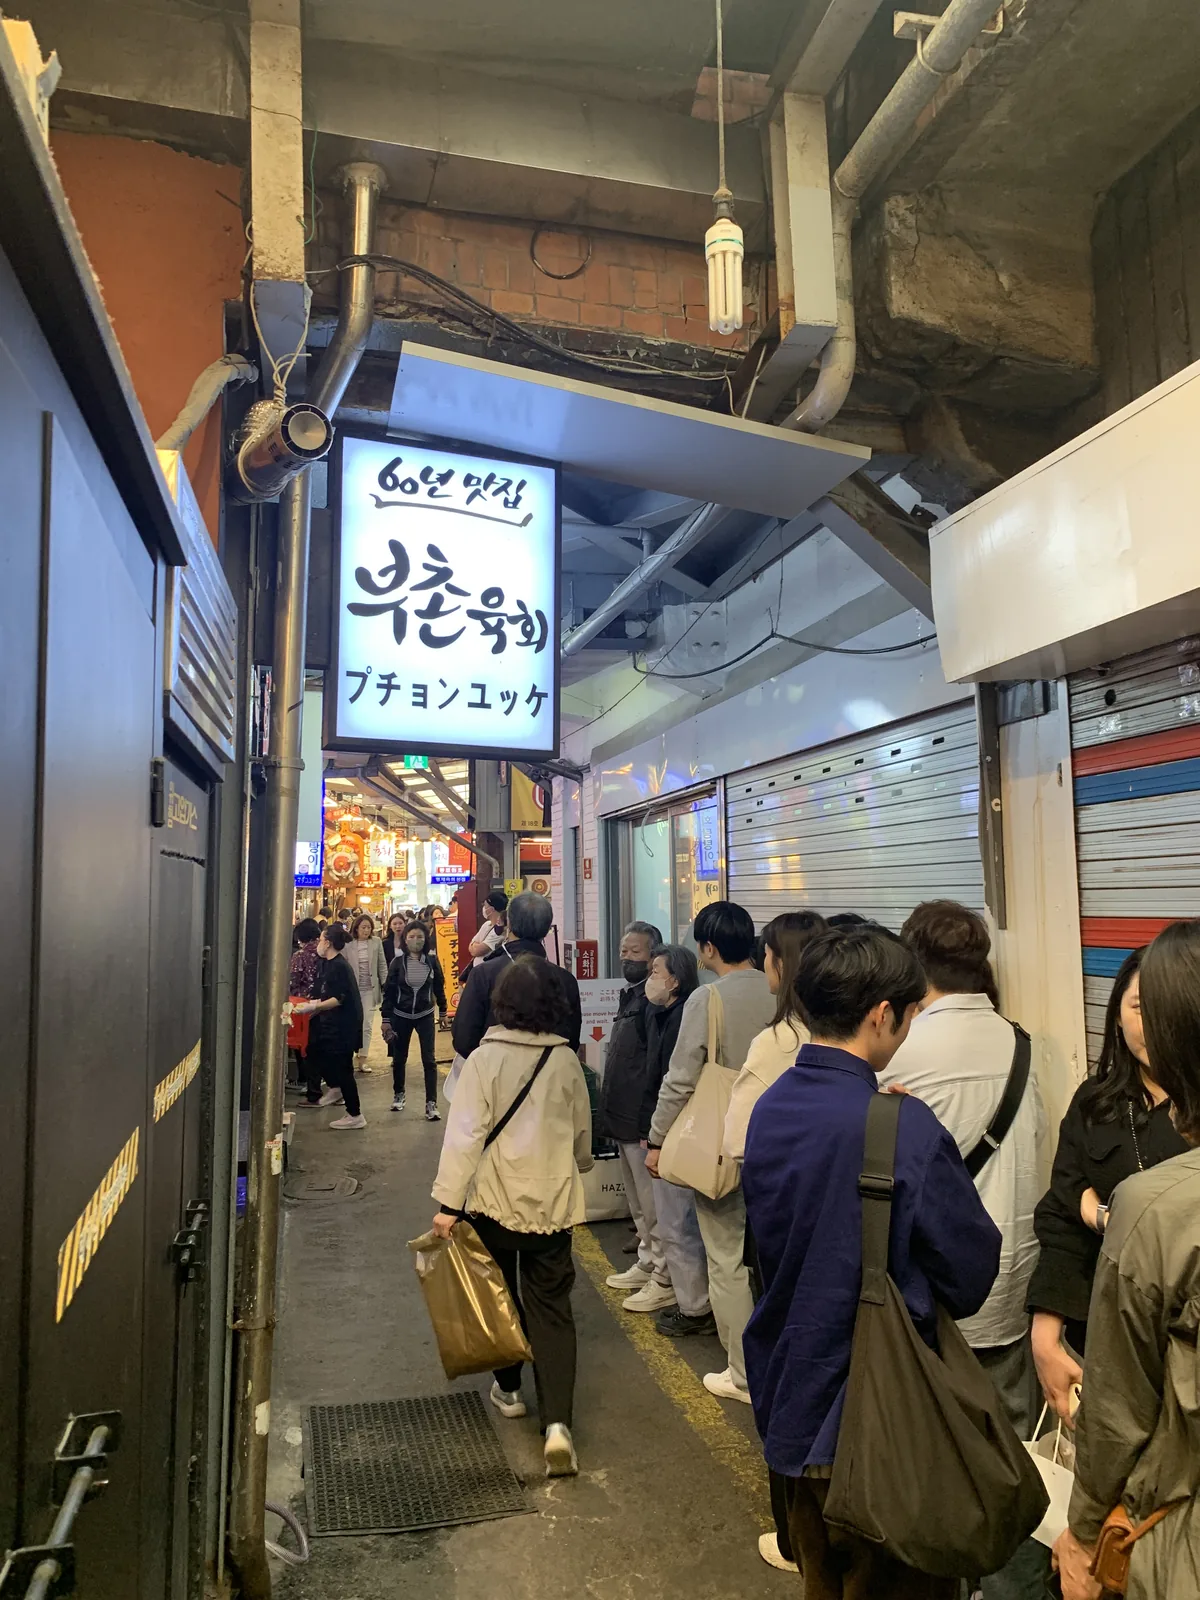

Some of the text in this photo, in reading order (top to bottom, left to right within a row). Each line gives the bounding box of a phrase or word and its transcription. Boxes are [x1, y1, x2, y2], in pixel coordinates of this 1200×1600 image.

[377, 456, 527, 509] 60년 맛집
[346, 538, 549, 655] 부촌육회
[345, 665, 549, 718] プチョンユッケ
[582, 950, 590, 977] 소화기
